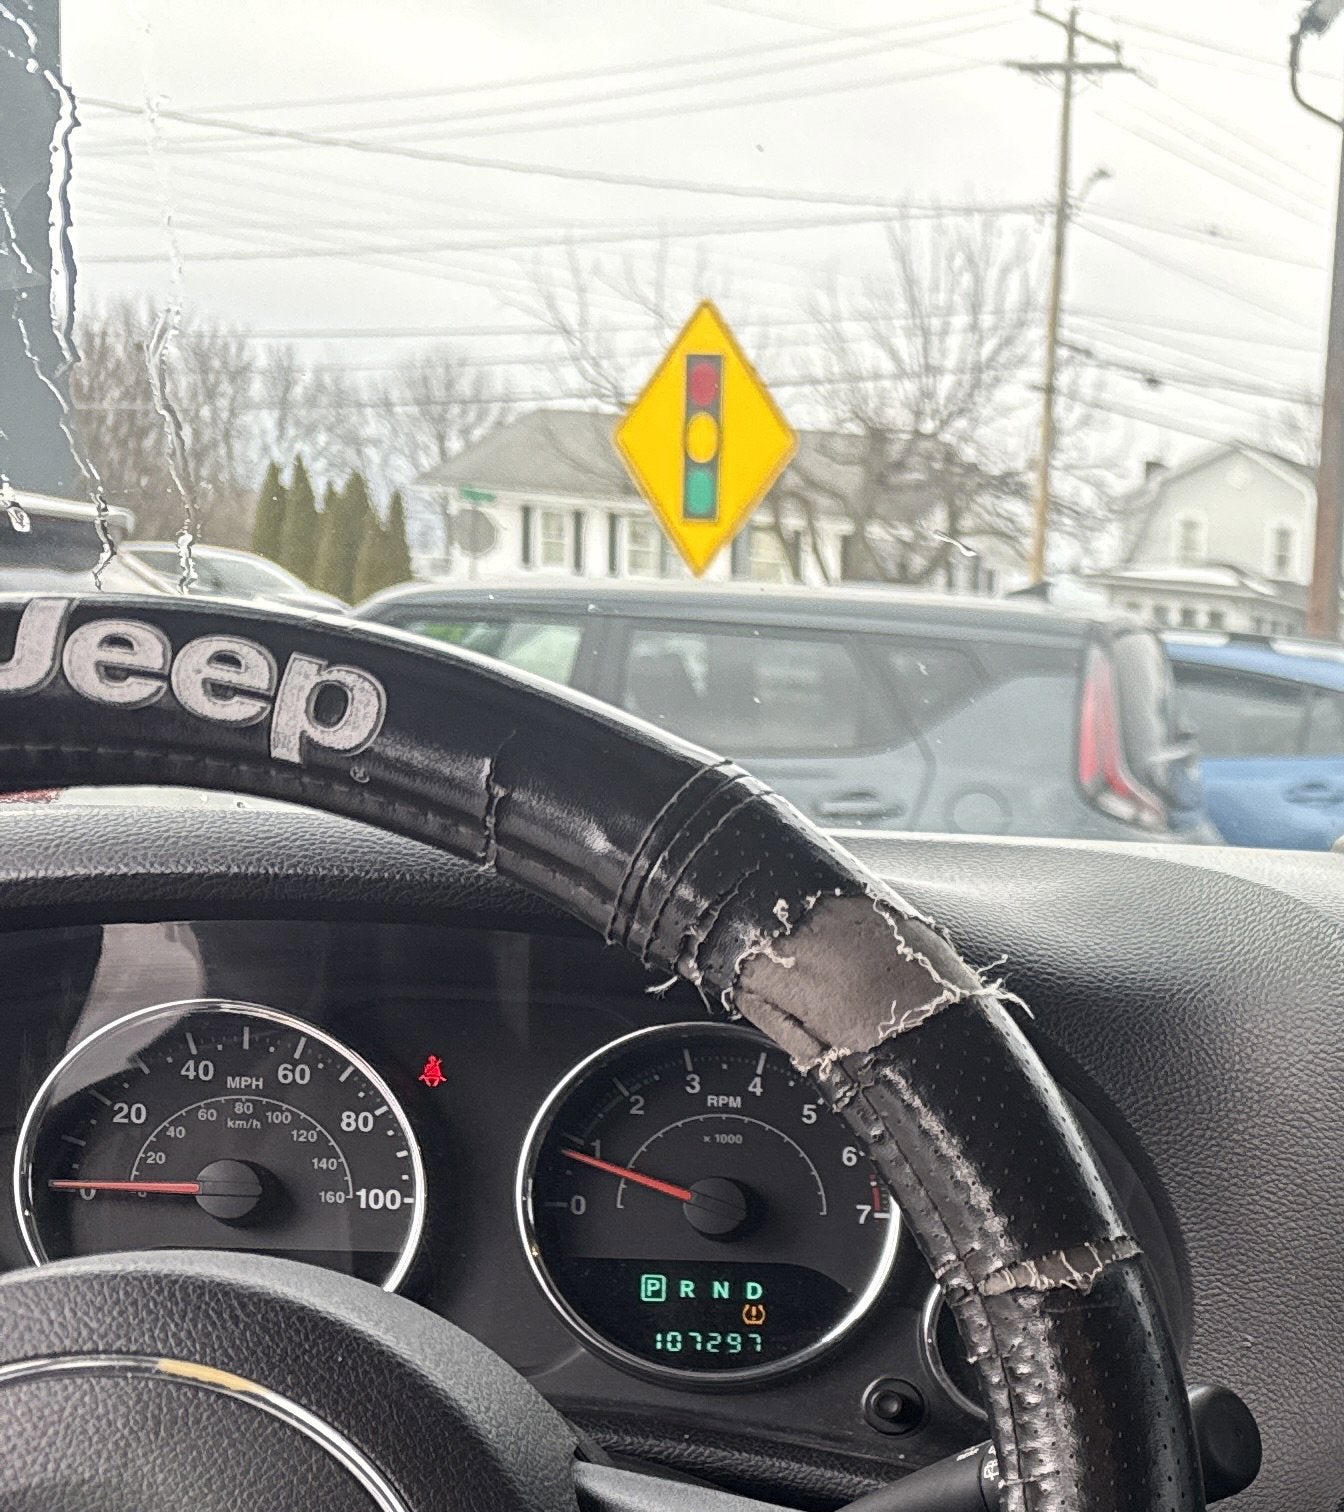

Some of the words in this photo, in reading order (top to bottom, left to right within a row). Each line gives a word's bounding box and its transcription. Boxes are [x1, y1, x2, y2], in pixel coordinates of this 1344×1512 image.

[0, 597, 387, 763] Jeep
[181, 1060, 214, 1080] 40
[278, 1064, 310, 1084] 60
[227, 1077, 263, 1090] MPH
[685, 1076, 700, 1094] 3
[748, 1077, 763, 1096] 4
[234, 1102, 253, 1114] 80
[629, 1097, 645, 1114] 2
[707, 1096, 741, 1108] RPM
[113, 1103, 146, 1124] 20
[198, 1109, 217, 1121] 60
[266, 1111, 291, 1123] 100
[341, 1112, 374, 1132] 80
[802, 1105, 816, 1124] 5
[227, 1117, 261, 1129] km/h
[166, 1126, 186, 1138] 40
[291, 1130, 317, 1142] 120
[714, 1133, 743, 1144] 1000
[146, 1152, 165, 1164] 20
[312, 1158, 337, 1170] 140
[842, 1147, 857, 1166] 6
[319, 1191, 345, 1203] 160
[357, 1189, 401, 1210] 100
[571, 1197, 586, 1214] 0
[856, 1206, 871, 1224] 7
[680, 1280, 695, 1298] R
[712, 1281, 729, 1299] N
[746, 1282, 762, 1299] D
[655, 1332, 762, 1353] 107297
